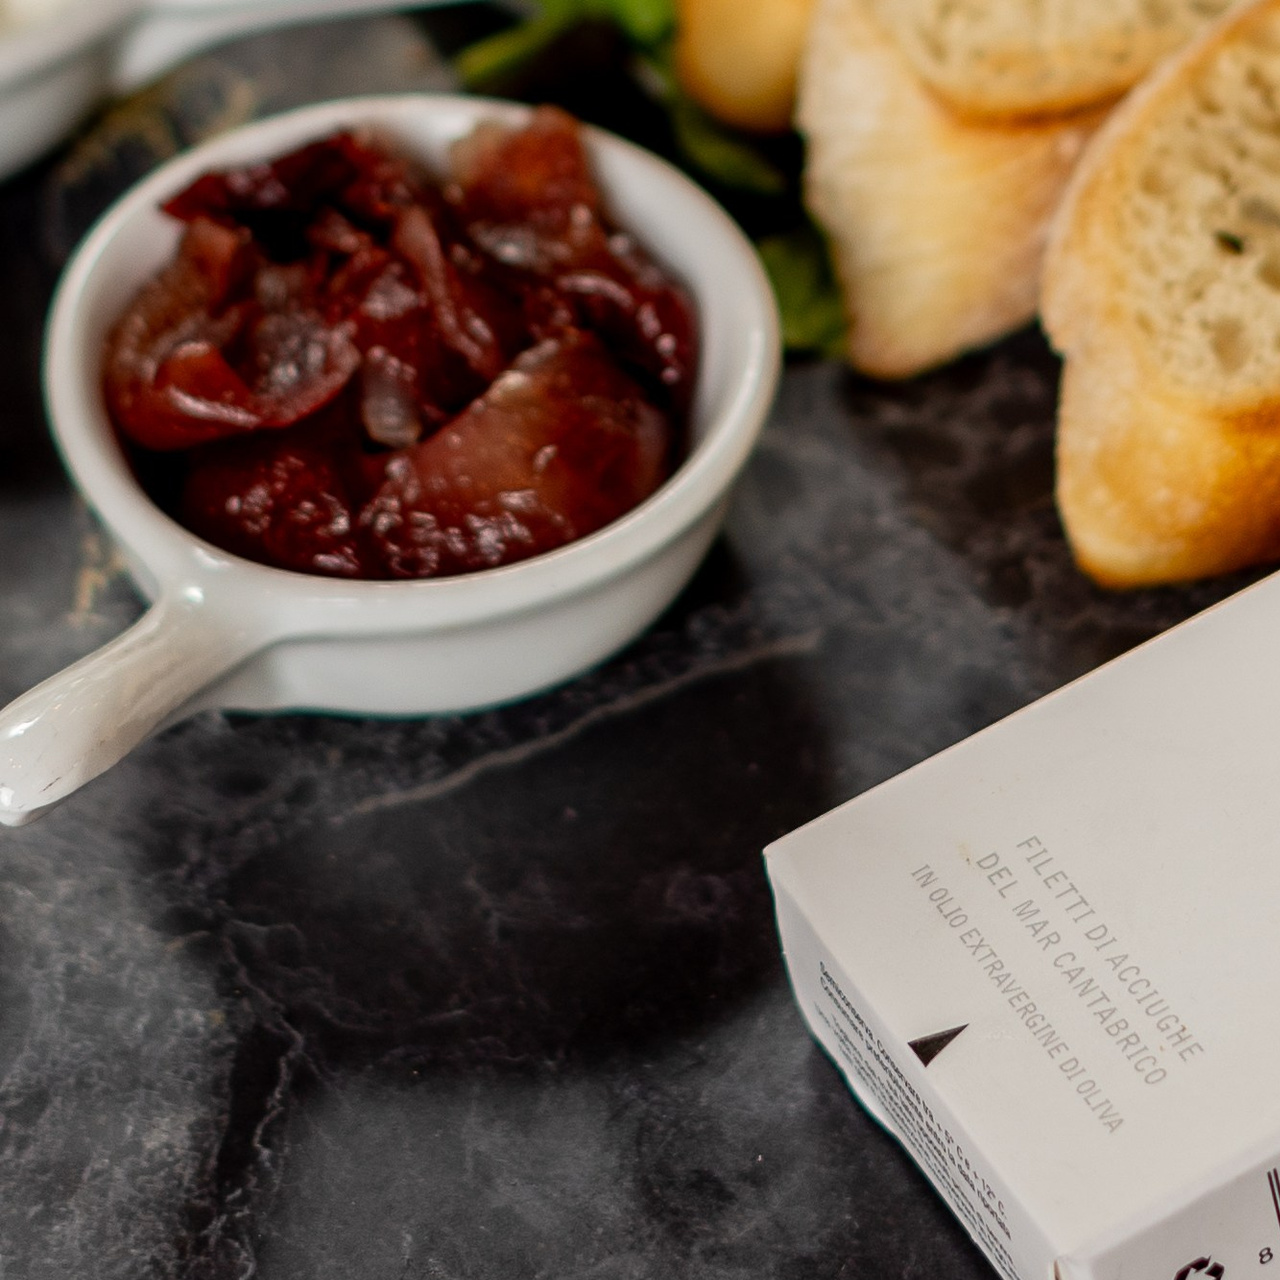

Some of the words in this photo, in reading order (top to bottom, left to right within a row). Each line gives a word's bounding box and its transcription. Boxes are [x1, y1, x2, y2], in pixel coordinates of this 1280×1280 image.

[911, 864, 938, 888] IN
[929, 888, 968, 928] OLIO
[959, 928, 1069, 1059] EXTRAVERGINE
[1059, 1057, 1086, 1081] DI
[1076, 1080, 1124, 1133] OLIVA
[976, 852, 1017, 899] DEL
[1012, 900, 1061, 951] MAR
[1053, 952, 1167, 1084] CANTABRICO
[1016, 836, 1095, 923] FILETTI
[1084, 924, 1117, 951] DI
[1104, 954, 1204, 1062] ACCIUGHE
[1259, 1247, 1273, 1264] 8
